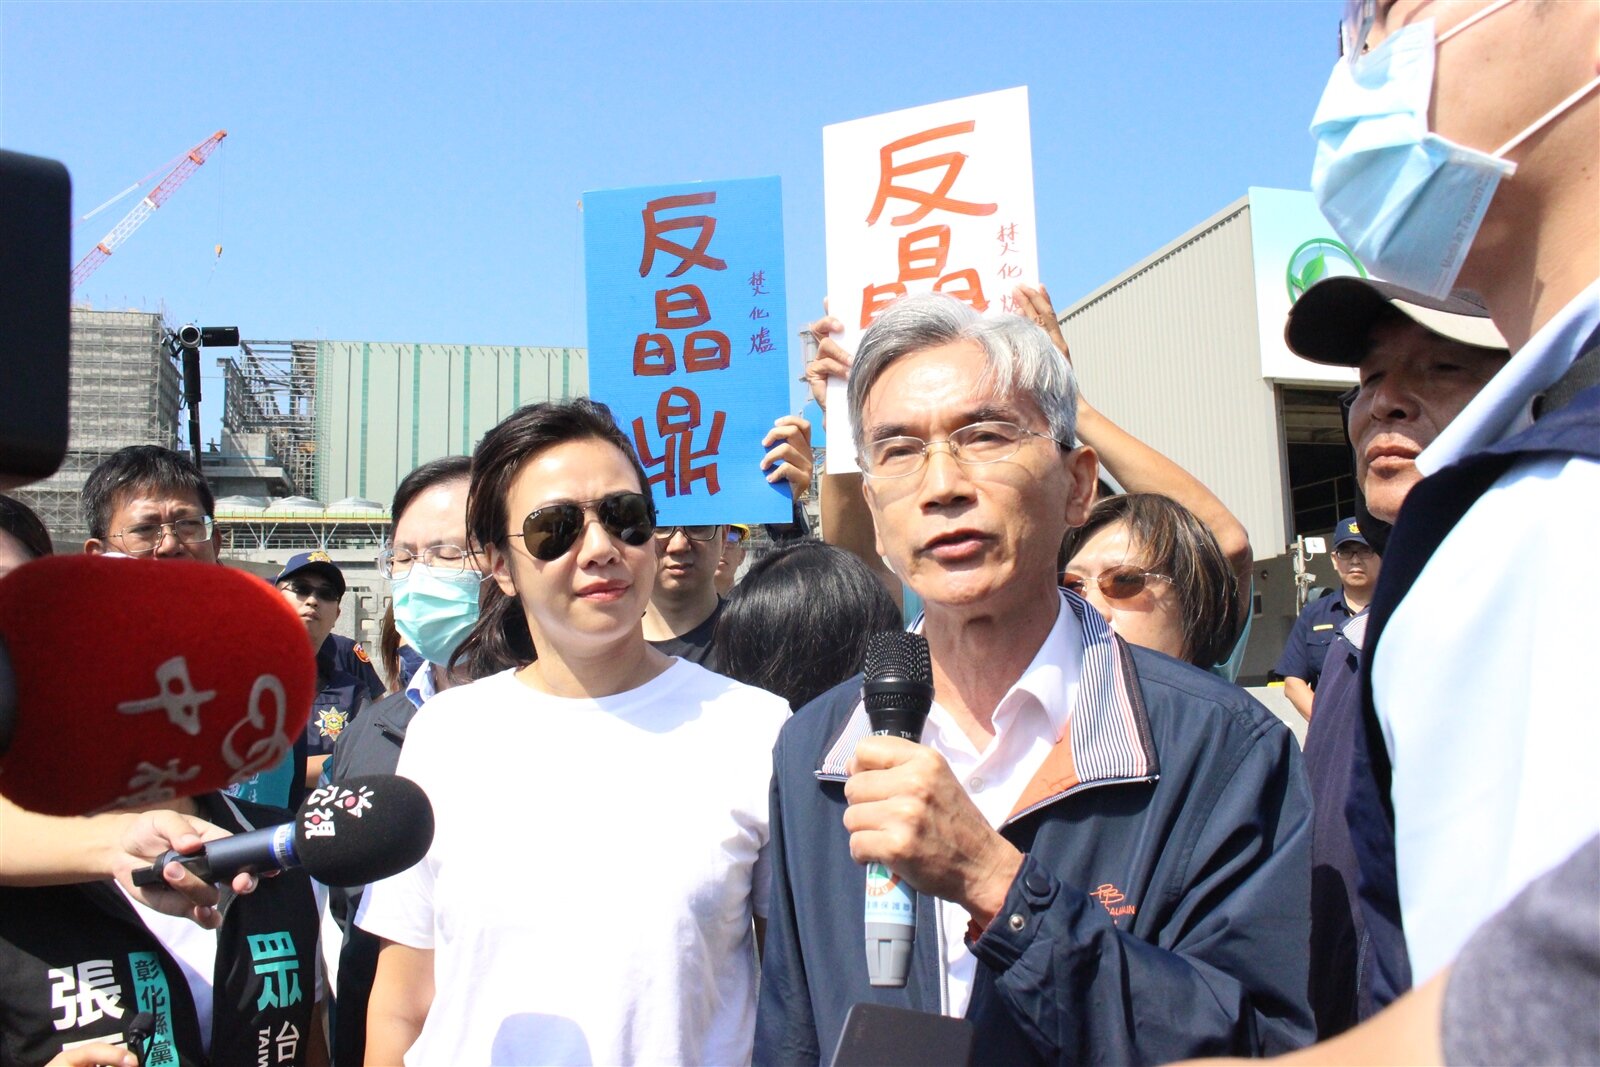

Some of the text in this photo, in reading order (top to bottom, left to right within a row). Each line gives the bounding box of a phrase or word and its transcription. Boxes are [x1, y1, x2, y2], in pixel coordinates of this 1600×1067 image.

[632, 191, 731, 498] 反晶鼎
[747, 269, 777, 356] 焚化爐
[276, 1020, 300, 1067] 台
